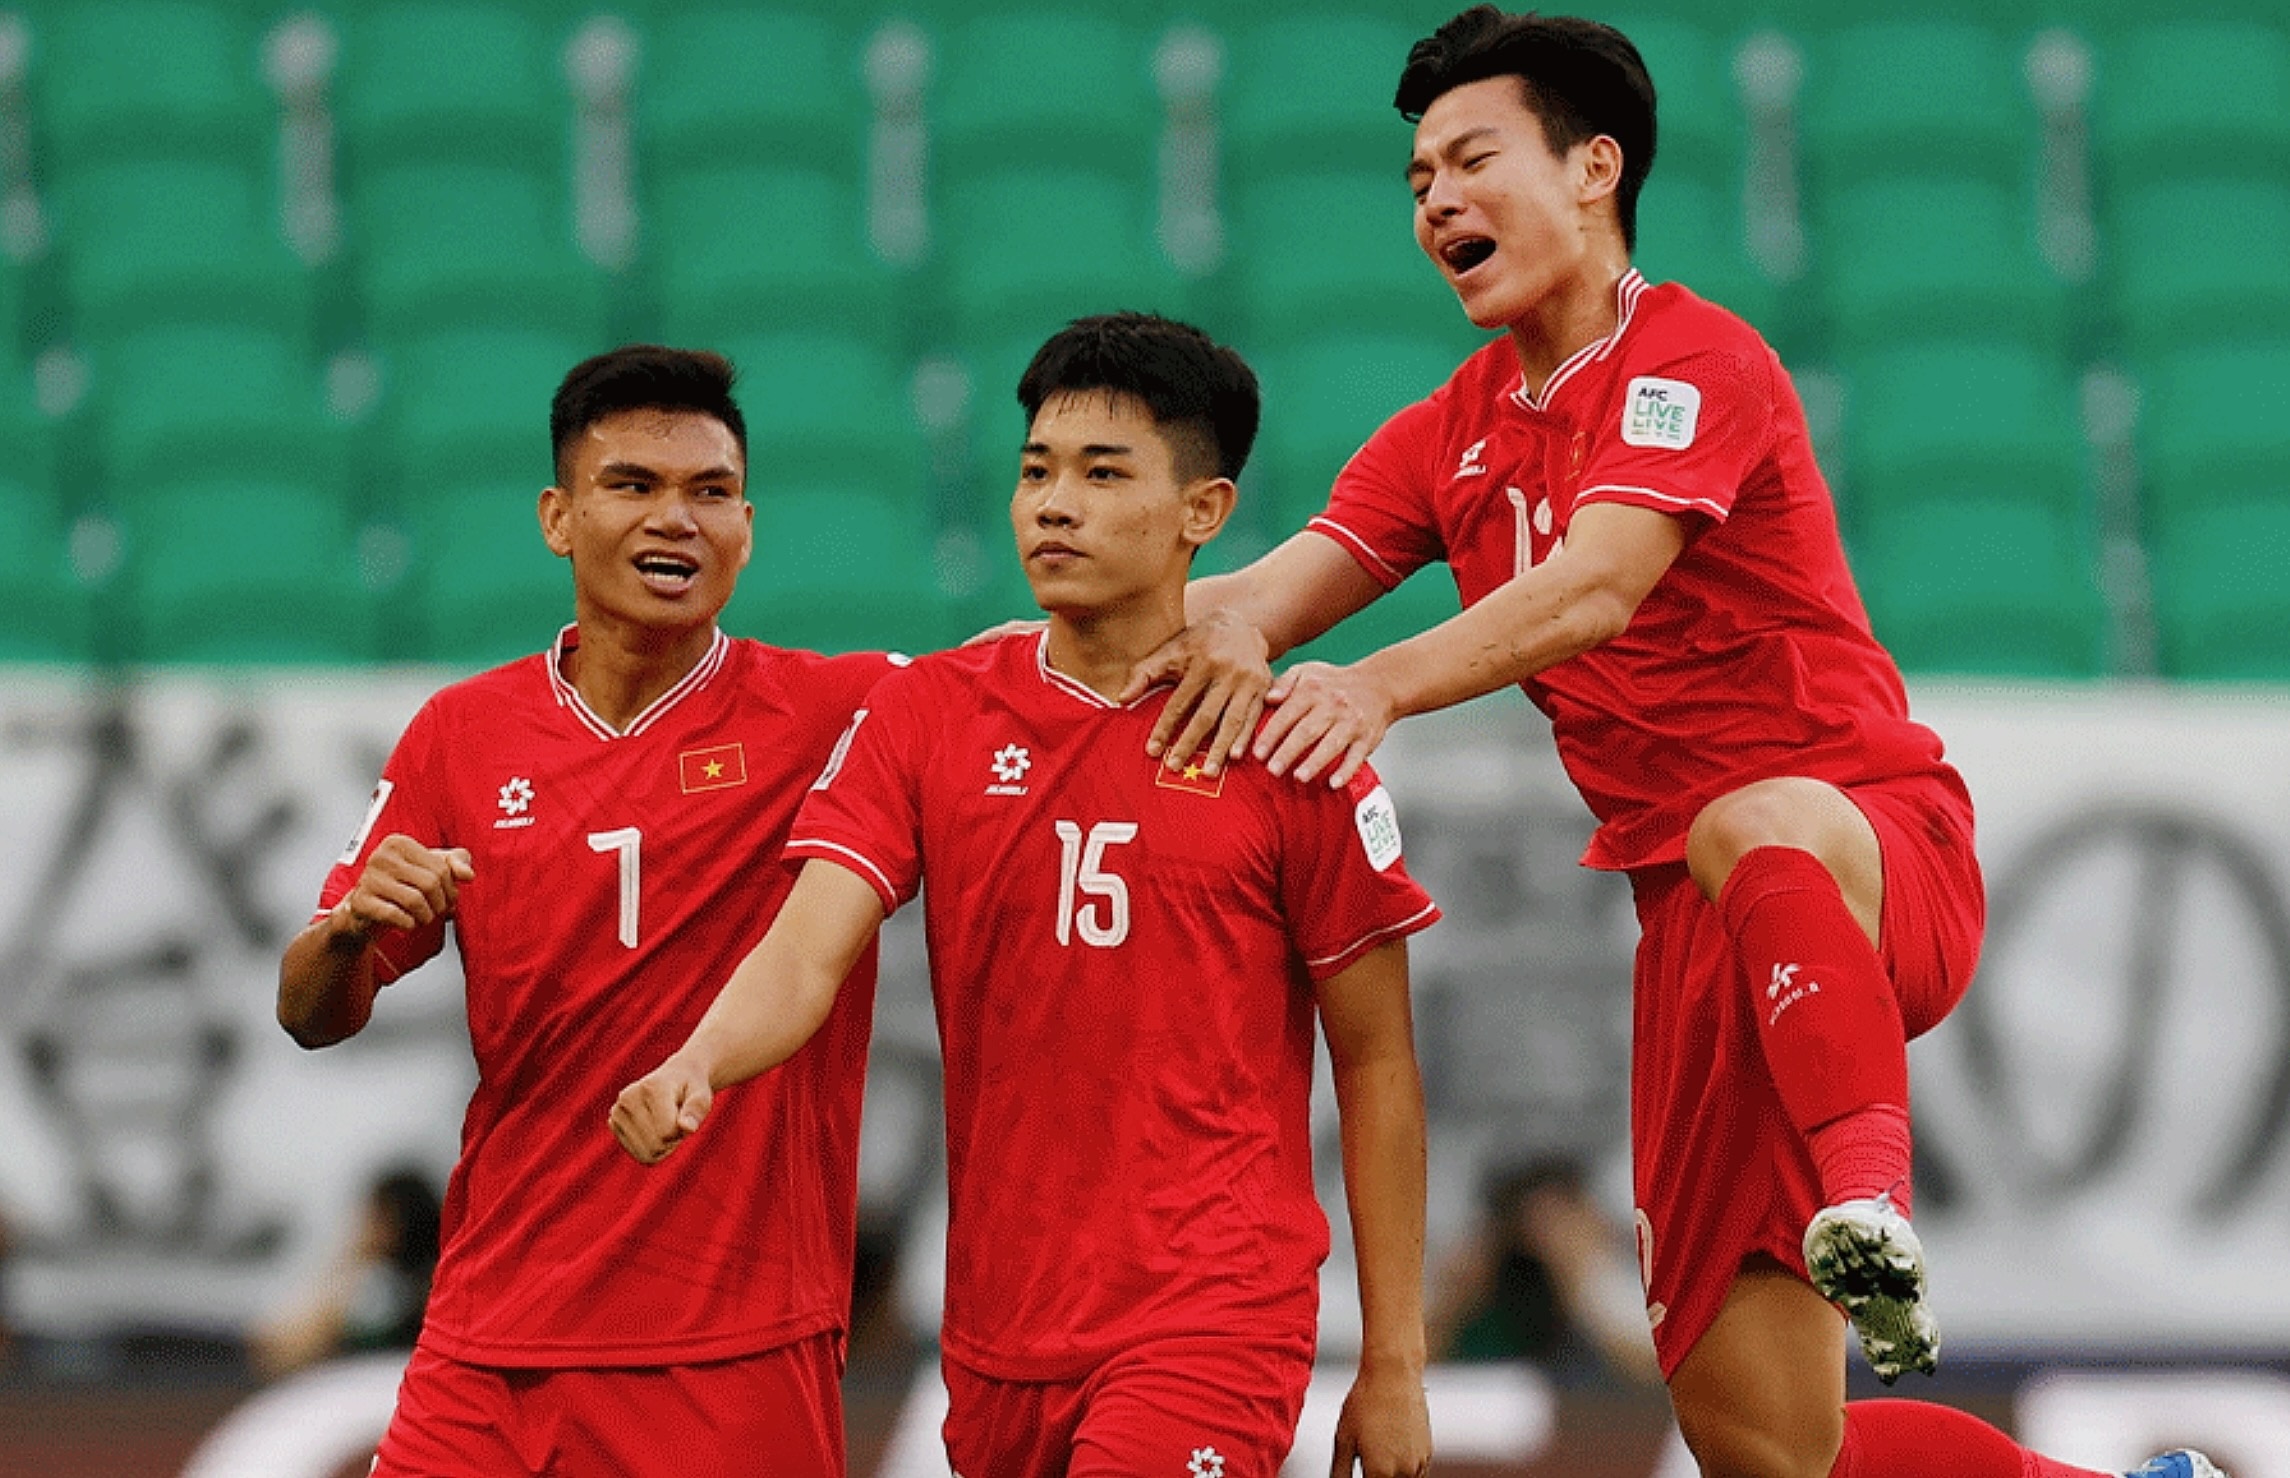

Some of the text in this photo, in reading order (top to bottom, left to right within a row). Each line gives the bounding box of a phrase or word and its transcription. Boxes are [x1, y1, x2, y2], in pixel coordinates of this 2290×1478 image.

[1635, 400, 1686, 422] LIVE
[1638, 387, 1669, 402] AFC
[587, 826, 643, 950] 7
[1055, 819, 1139, 948] 15
